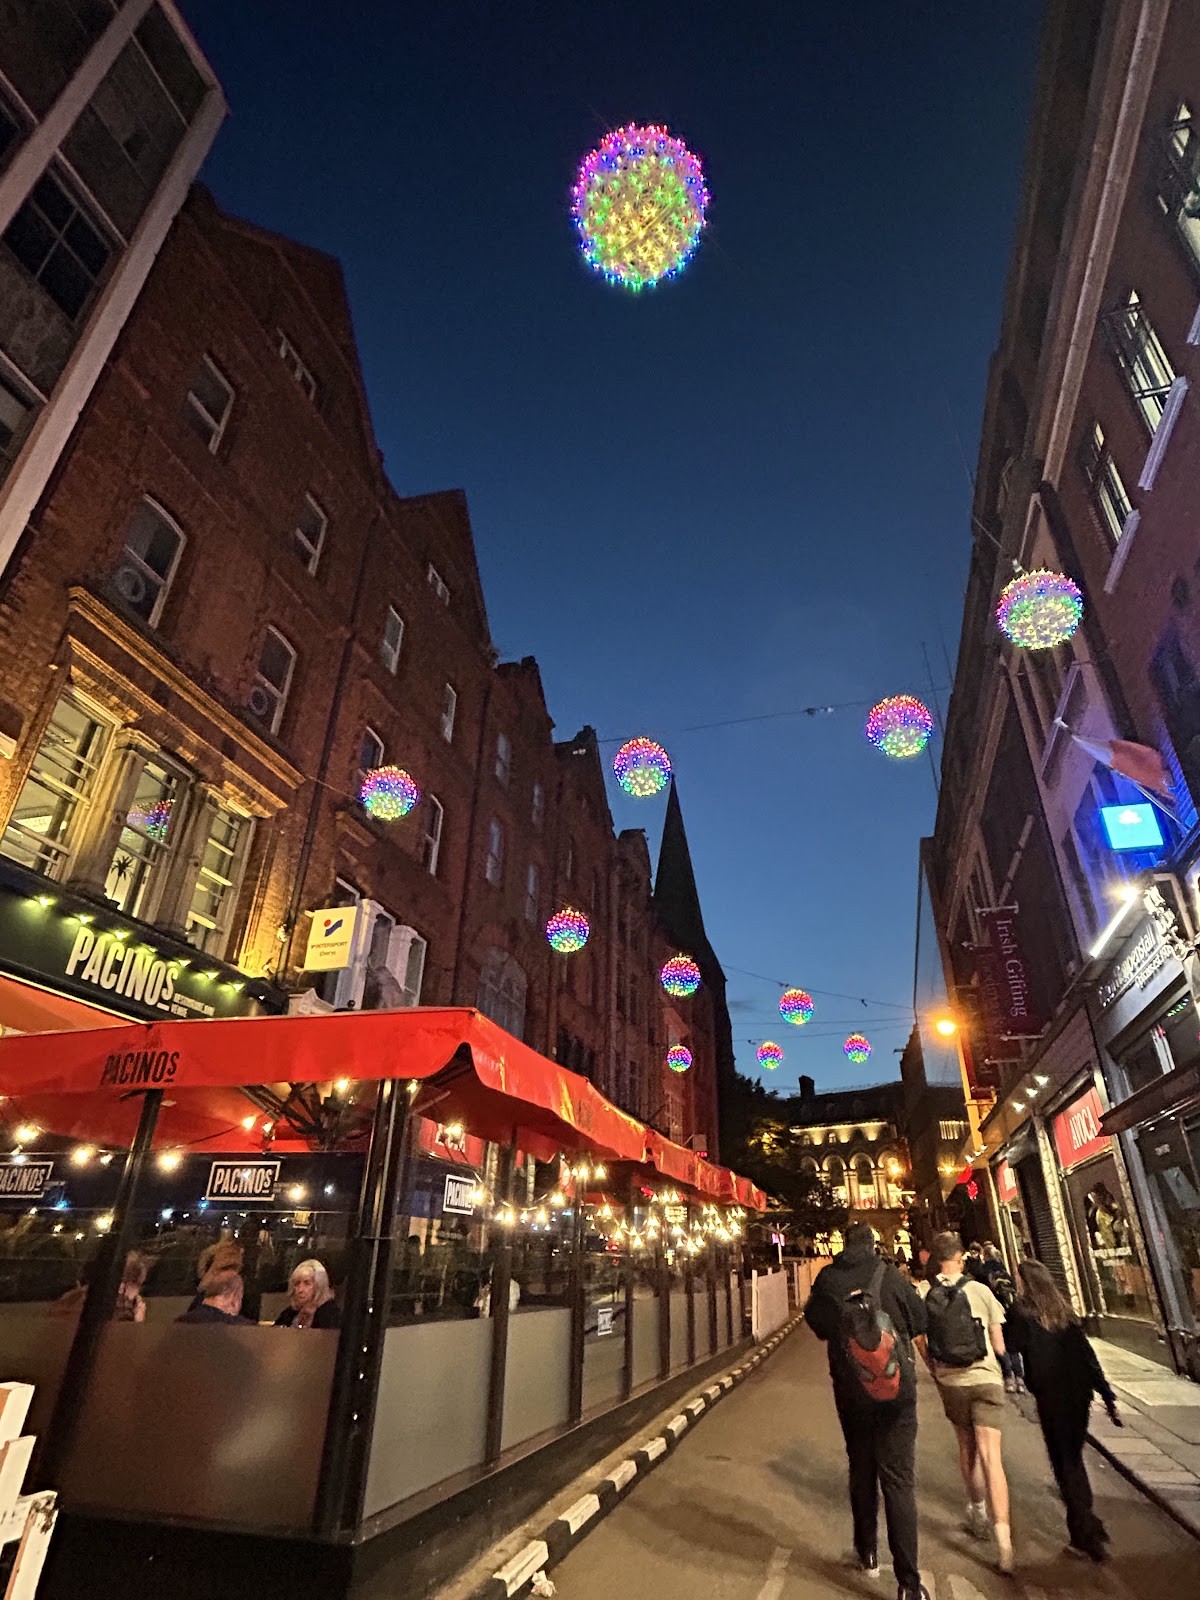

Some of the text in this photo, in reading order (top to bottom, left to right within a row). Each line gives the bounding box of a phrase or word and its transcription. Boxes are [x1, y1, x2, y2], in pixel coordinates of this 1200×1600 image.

[65, 926, 179, 1007] PACINOS
[996, 918, 1028, 1017] Irish Gifting
[1069, 1106, 1098, 1150] AVOCA
[212, 1168, 273, 1193] PACINOS
